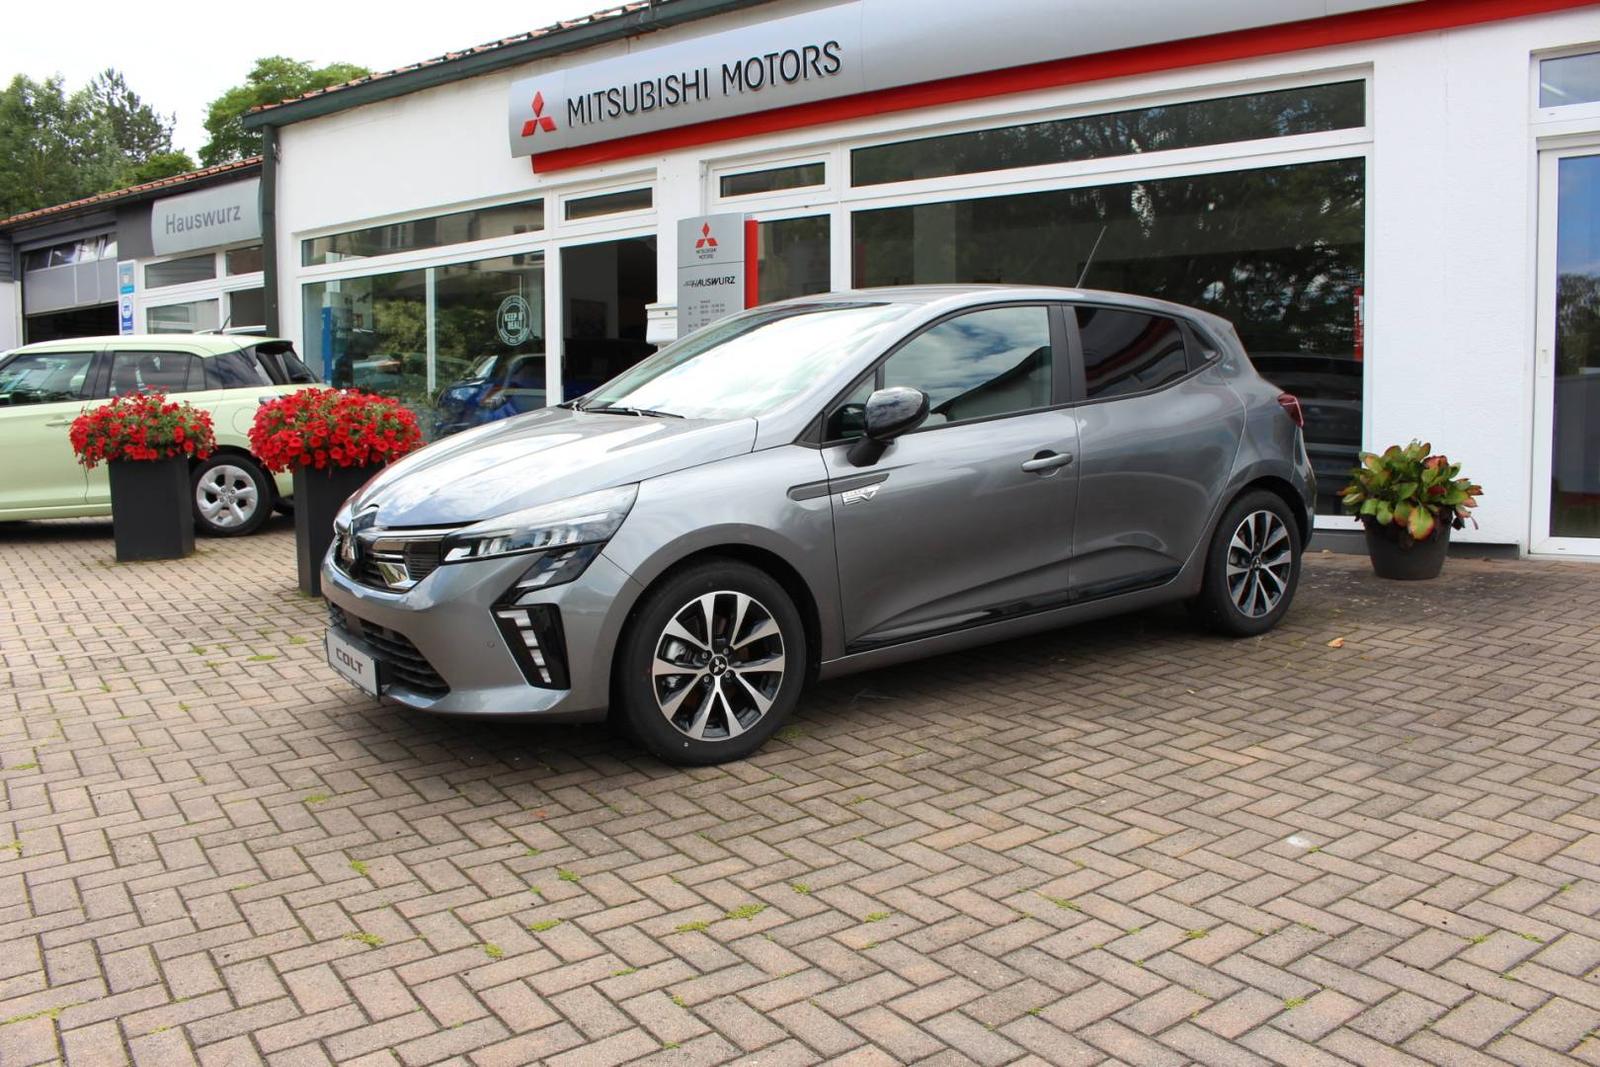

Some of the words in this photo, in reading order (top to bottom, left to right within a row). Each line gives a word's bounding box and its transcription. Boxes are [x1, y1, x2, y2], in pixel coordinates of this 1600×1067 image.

[567, 67, 710, 127] MITSUBISHI
[721, 40, 842, 95] MOTORS
[165, 205, 241, 234] Hauswurz
[336, 647, 363, 674] COLT
